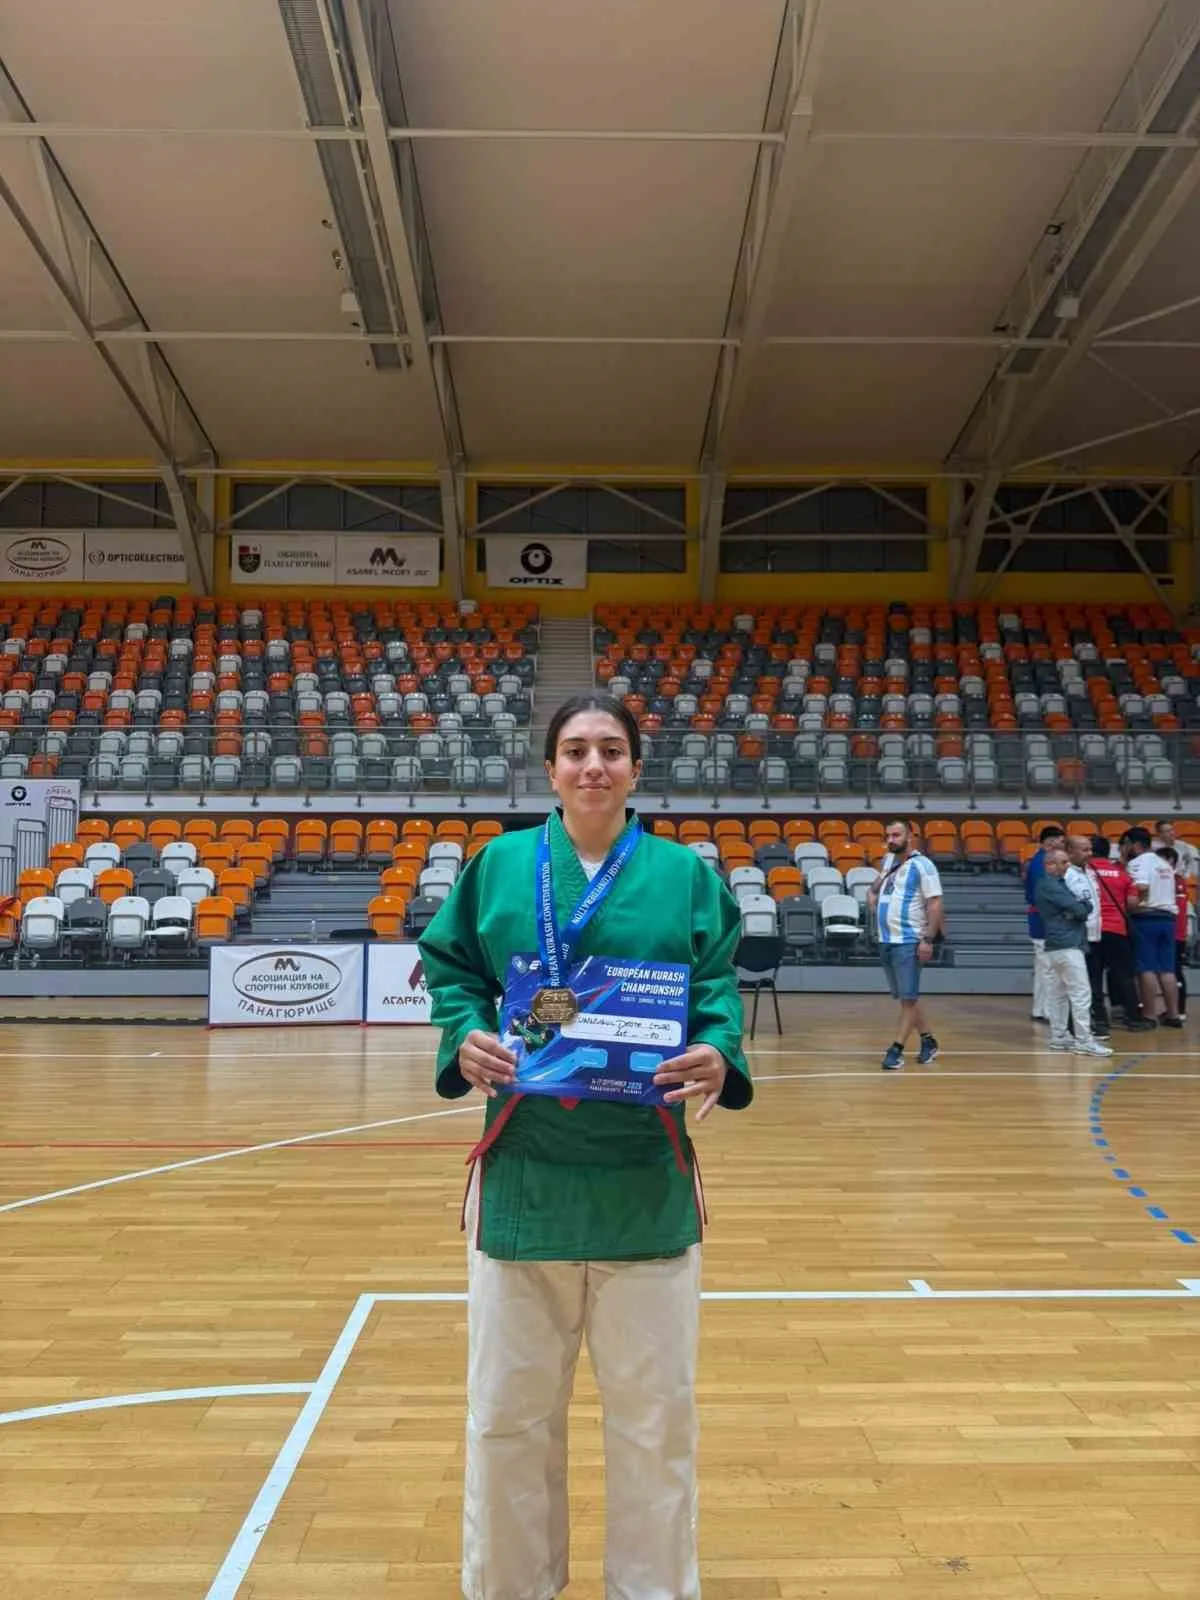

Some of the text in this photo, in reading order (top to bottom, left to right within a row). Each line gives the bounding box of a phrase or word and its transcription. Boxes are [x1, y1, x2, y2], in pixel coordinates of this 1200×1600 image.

[509, 577, 563, 585] OPTIX
[542, 862, 552, 920] CONFEDERATION
[544, 921, 556, 954] KURASH
[252, 973, 323, 982] АСОЦИАЦИЯ НА
[607, 966, 685, 982] EUROPEAN KURASH
[244, 982, 330, 992] СПОРТНИ КЛУБОВЕ
[621, 982, 684, 997] CHAMPIONSHIP
[238, 998, 337, 1019] ПАНАГЮРИЩЕ
